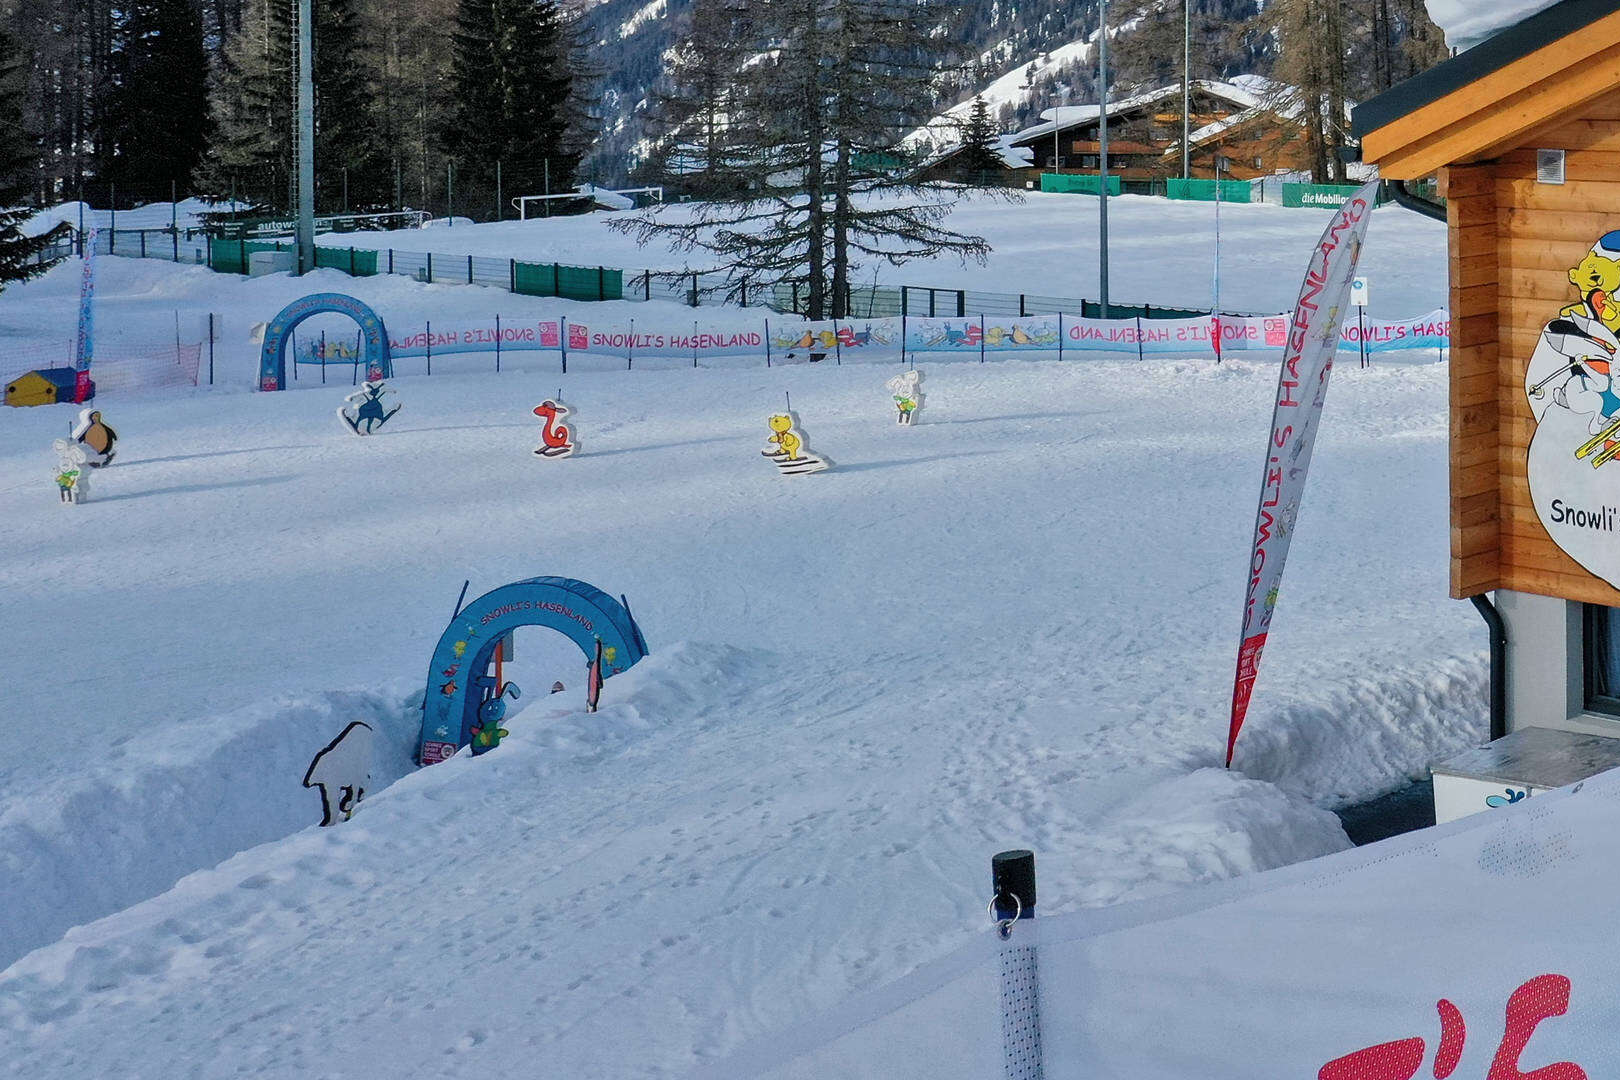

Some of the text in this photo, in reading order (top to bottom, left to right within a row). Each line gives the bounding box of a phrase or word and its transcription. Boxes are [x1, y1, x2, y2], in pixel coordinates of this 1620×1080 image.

[1301, 192, 1314, 203] die
[592, 333, 664, 348] SNOWLI'S
[670, 332, 762, 349] HASENLAND
